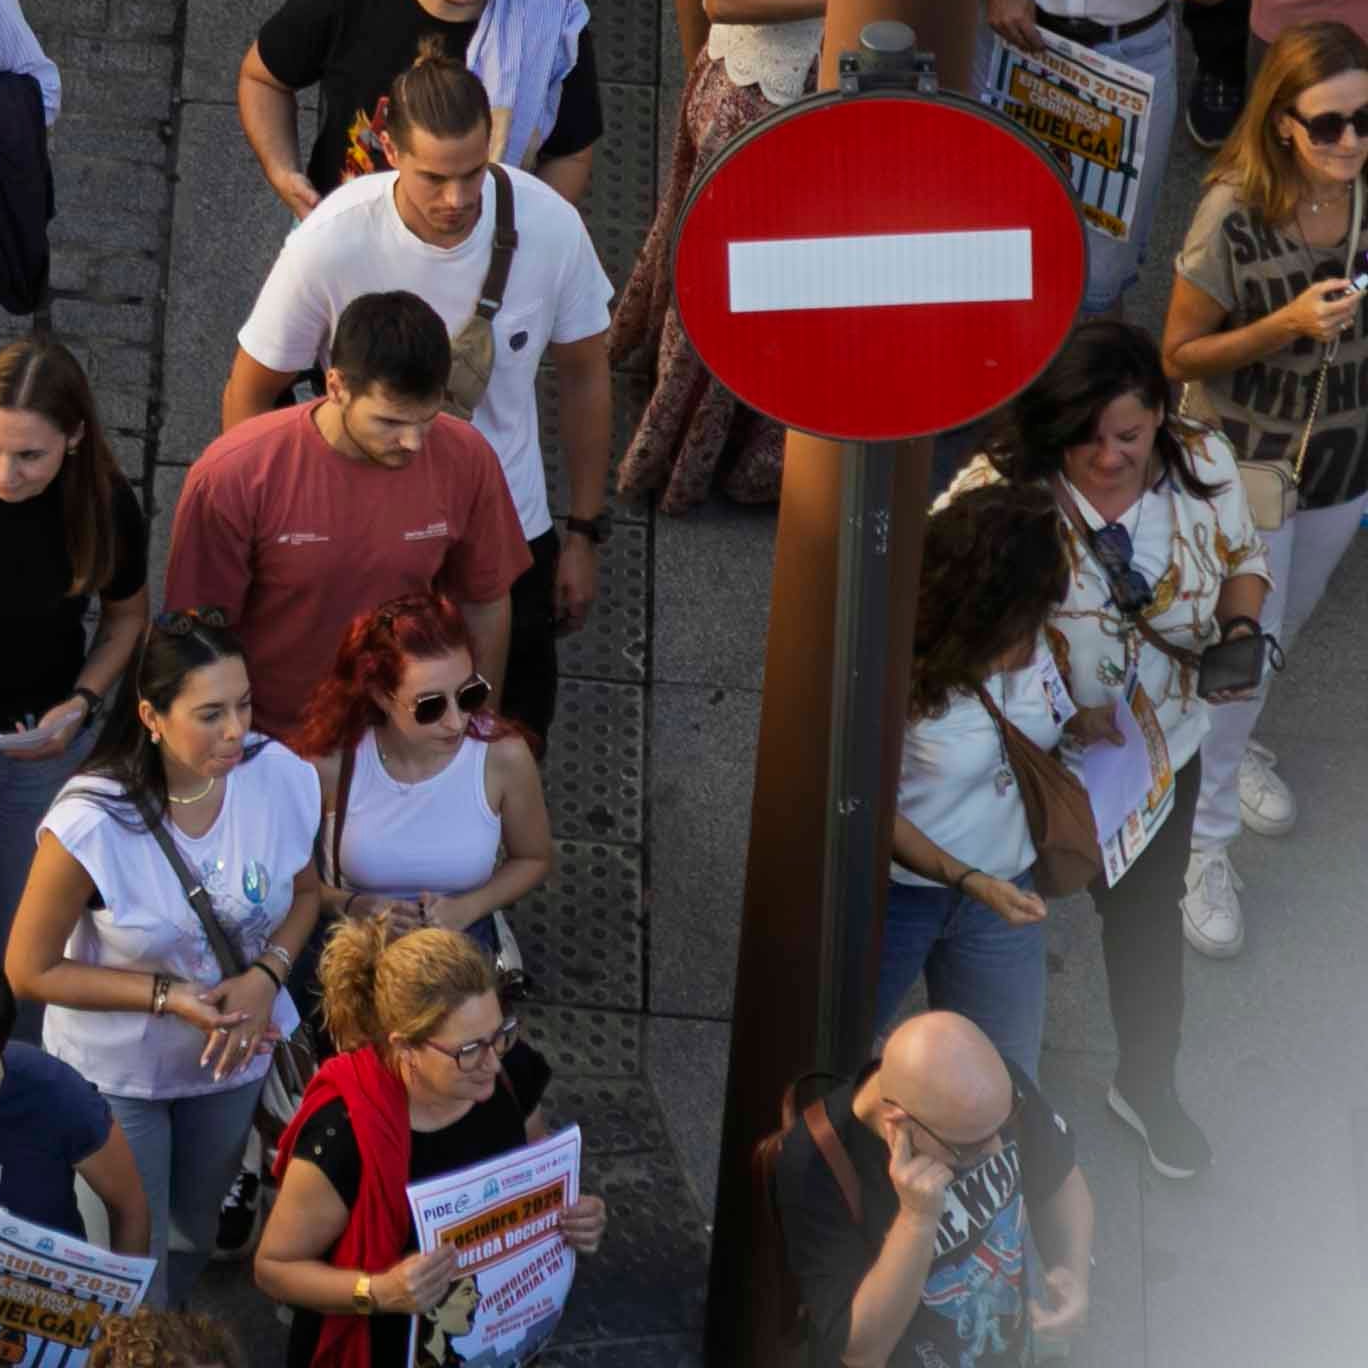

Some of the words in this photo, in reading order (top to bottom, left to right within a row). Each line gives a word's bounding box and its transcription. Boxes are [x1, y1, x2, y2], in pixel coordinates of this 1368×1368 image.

[1093, 80, 1144, 113] 2025
[423, 1200, 454, 1223] PIDE
[453, 1208, 518, 1249] octubre
[523, 1189, 563, 1219] 2025
[457, 1235, 504, 1269] UELGA
[74, 1273, 133, 1300] 2025
